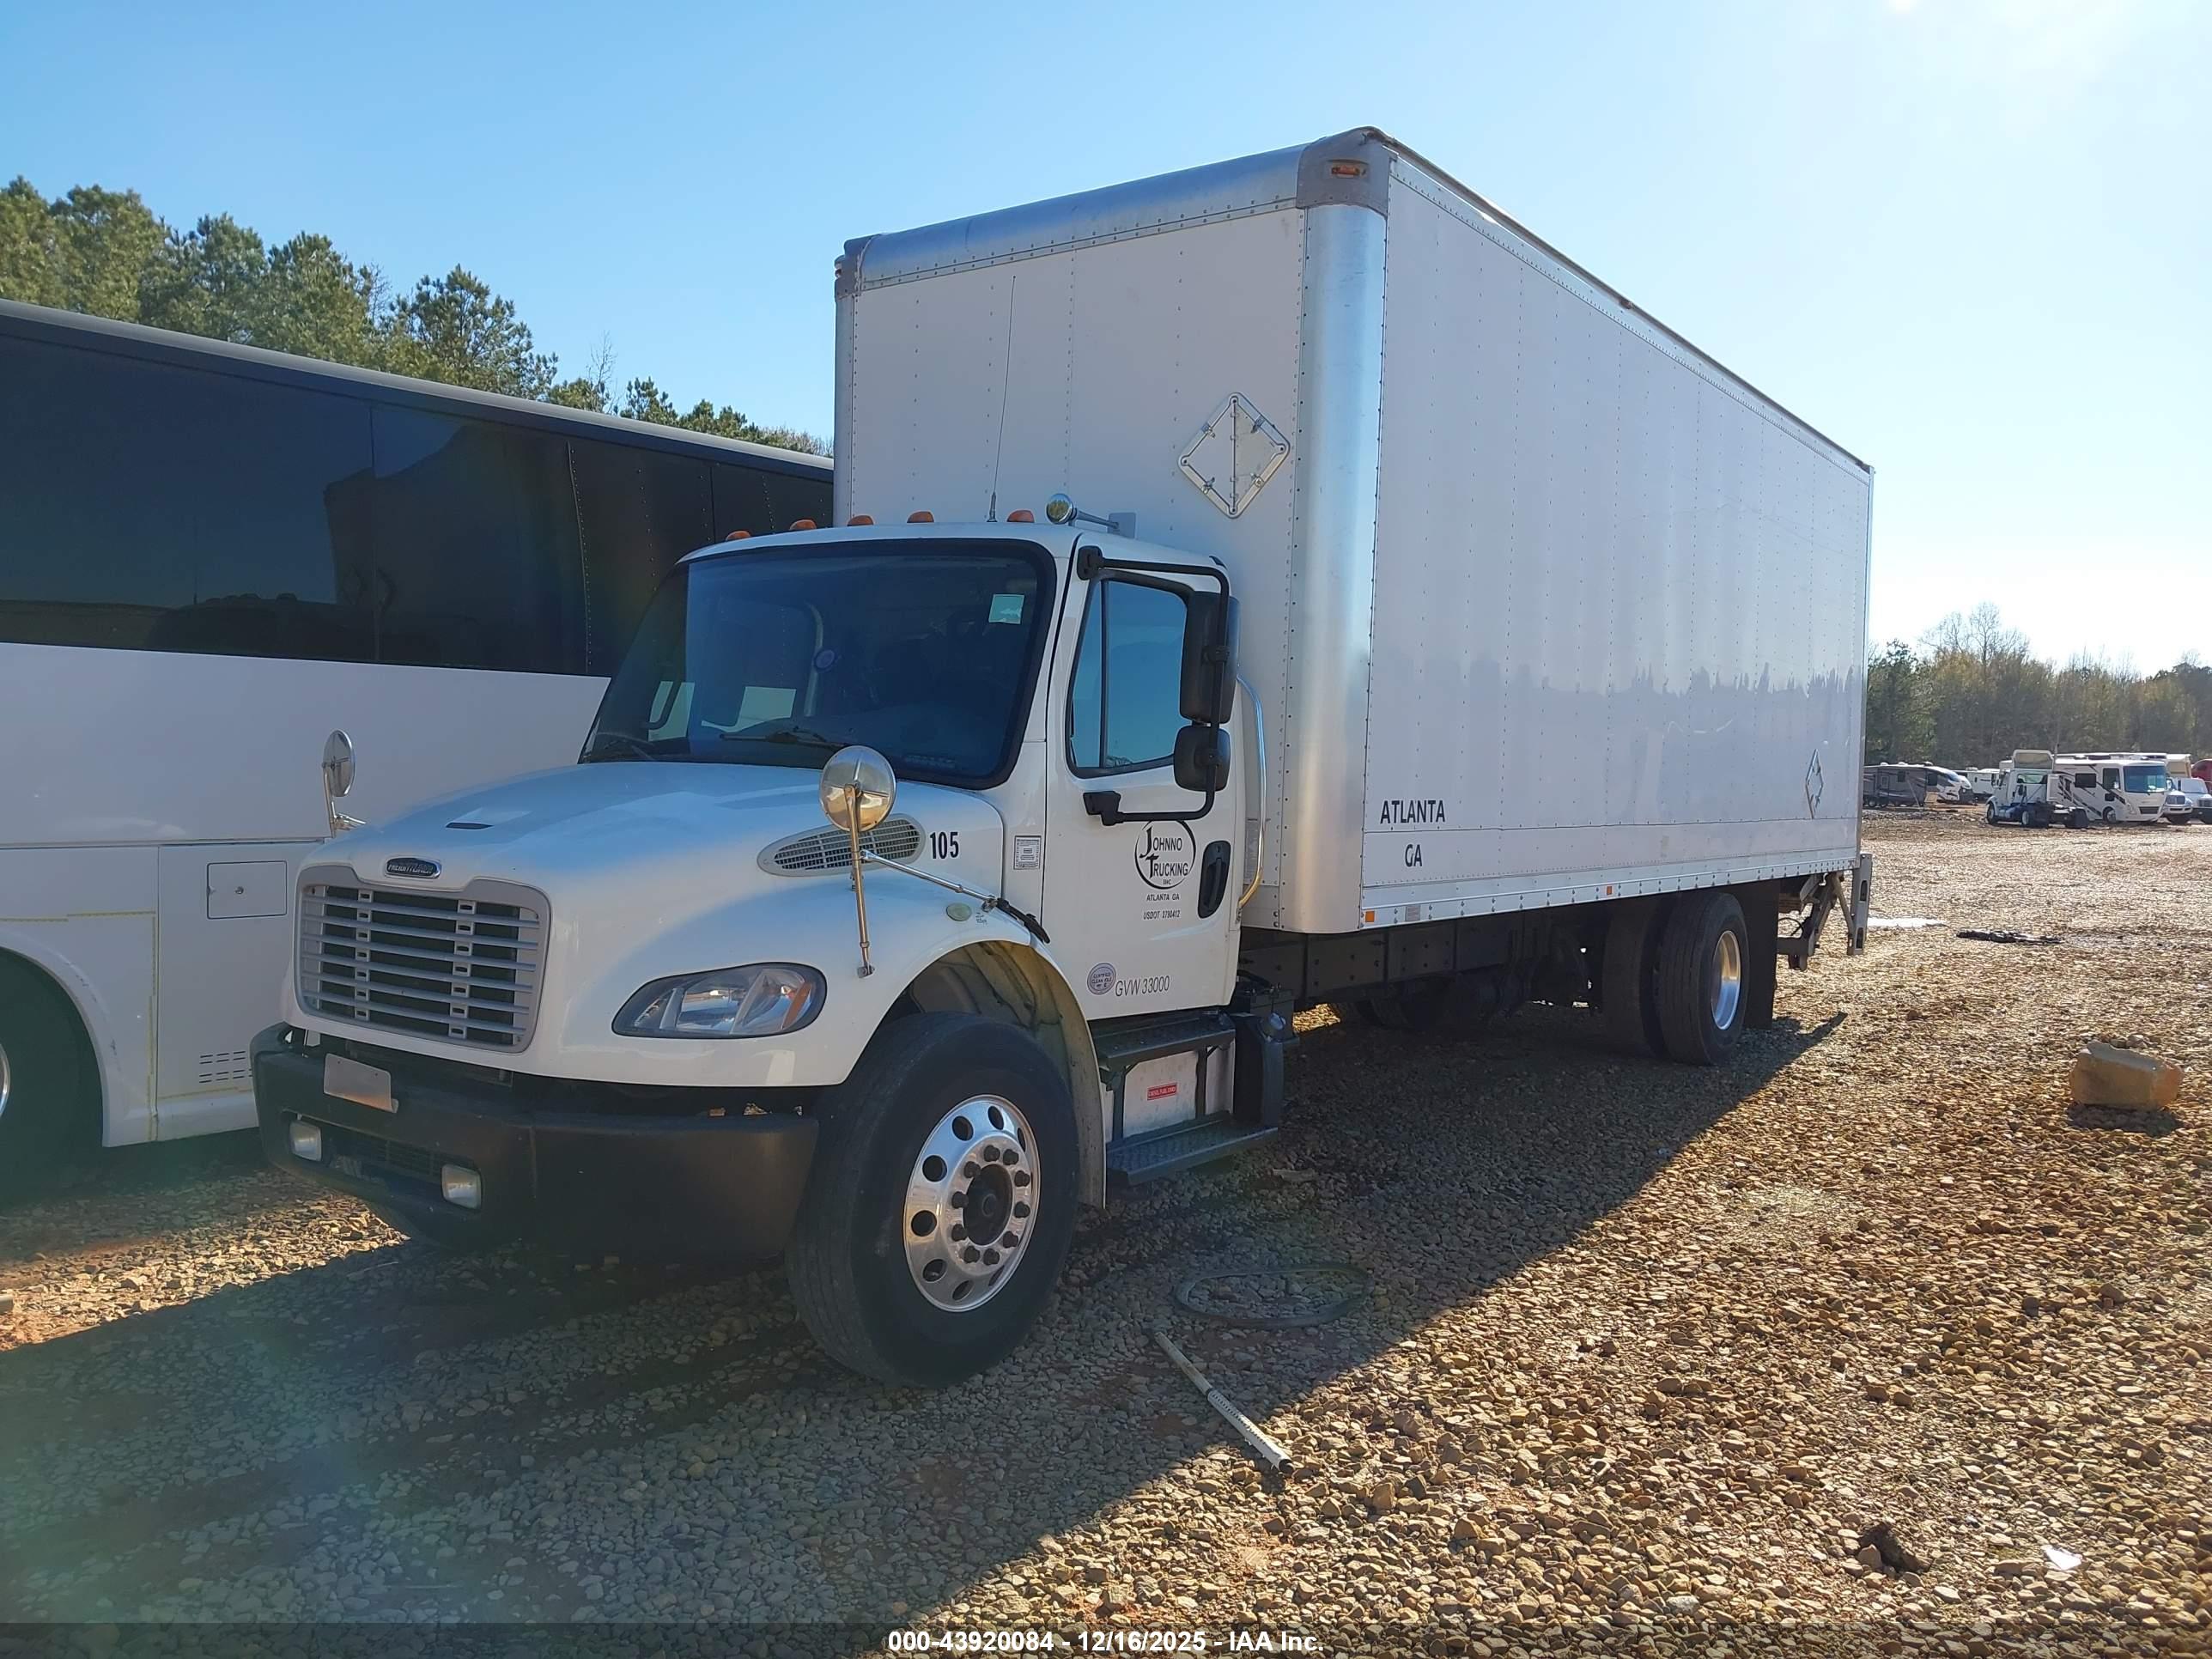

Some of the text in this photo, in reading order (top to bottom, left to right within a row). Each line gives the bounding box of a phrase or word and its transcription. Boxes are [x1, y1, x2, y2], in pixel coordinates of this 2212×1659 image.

[1380, 800, 1445, 824] ATLANTA
[930, 831, 959, 859] 105
[1139, 826, 1182, 858] JOHNNO
[1145, 854, 1189, 879] TRUCKING
[1405, 844, 1423, 867] GA
[1146, 893, 1170, 902] ATLANTA
[1143, 910, 1160, 920] USDOT
[1115, 975, 1170, 996] GVW 33000
